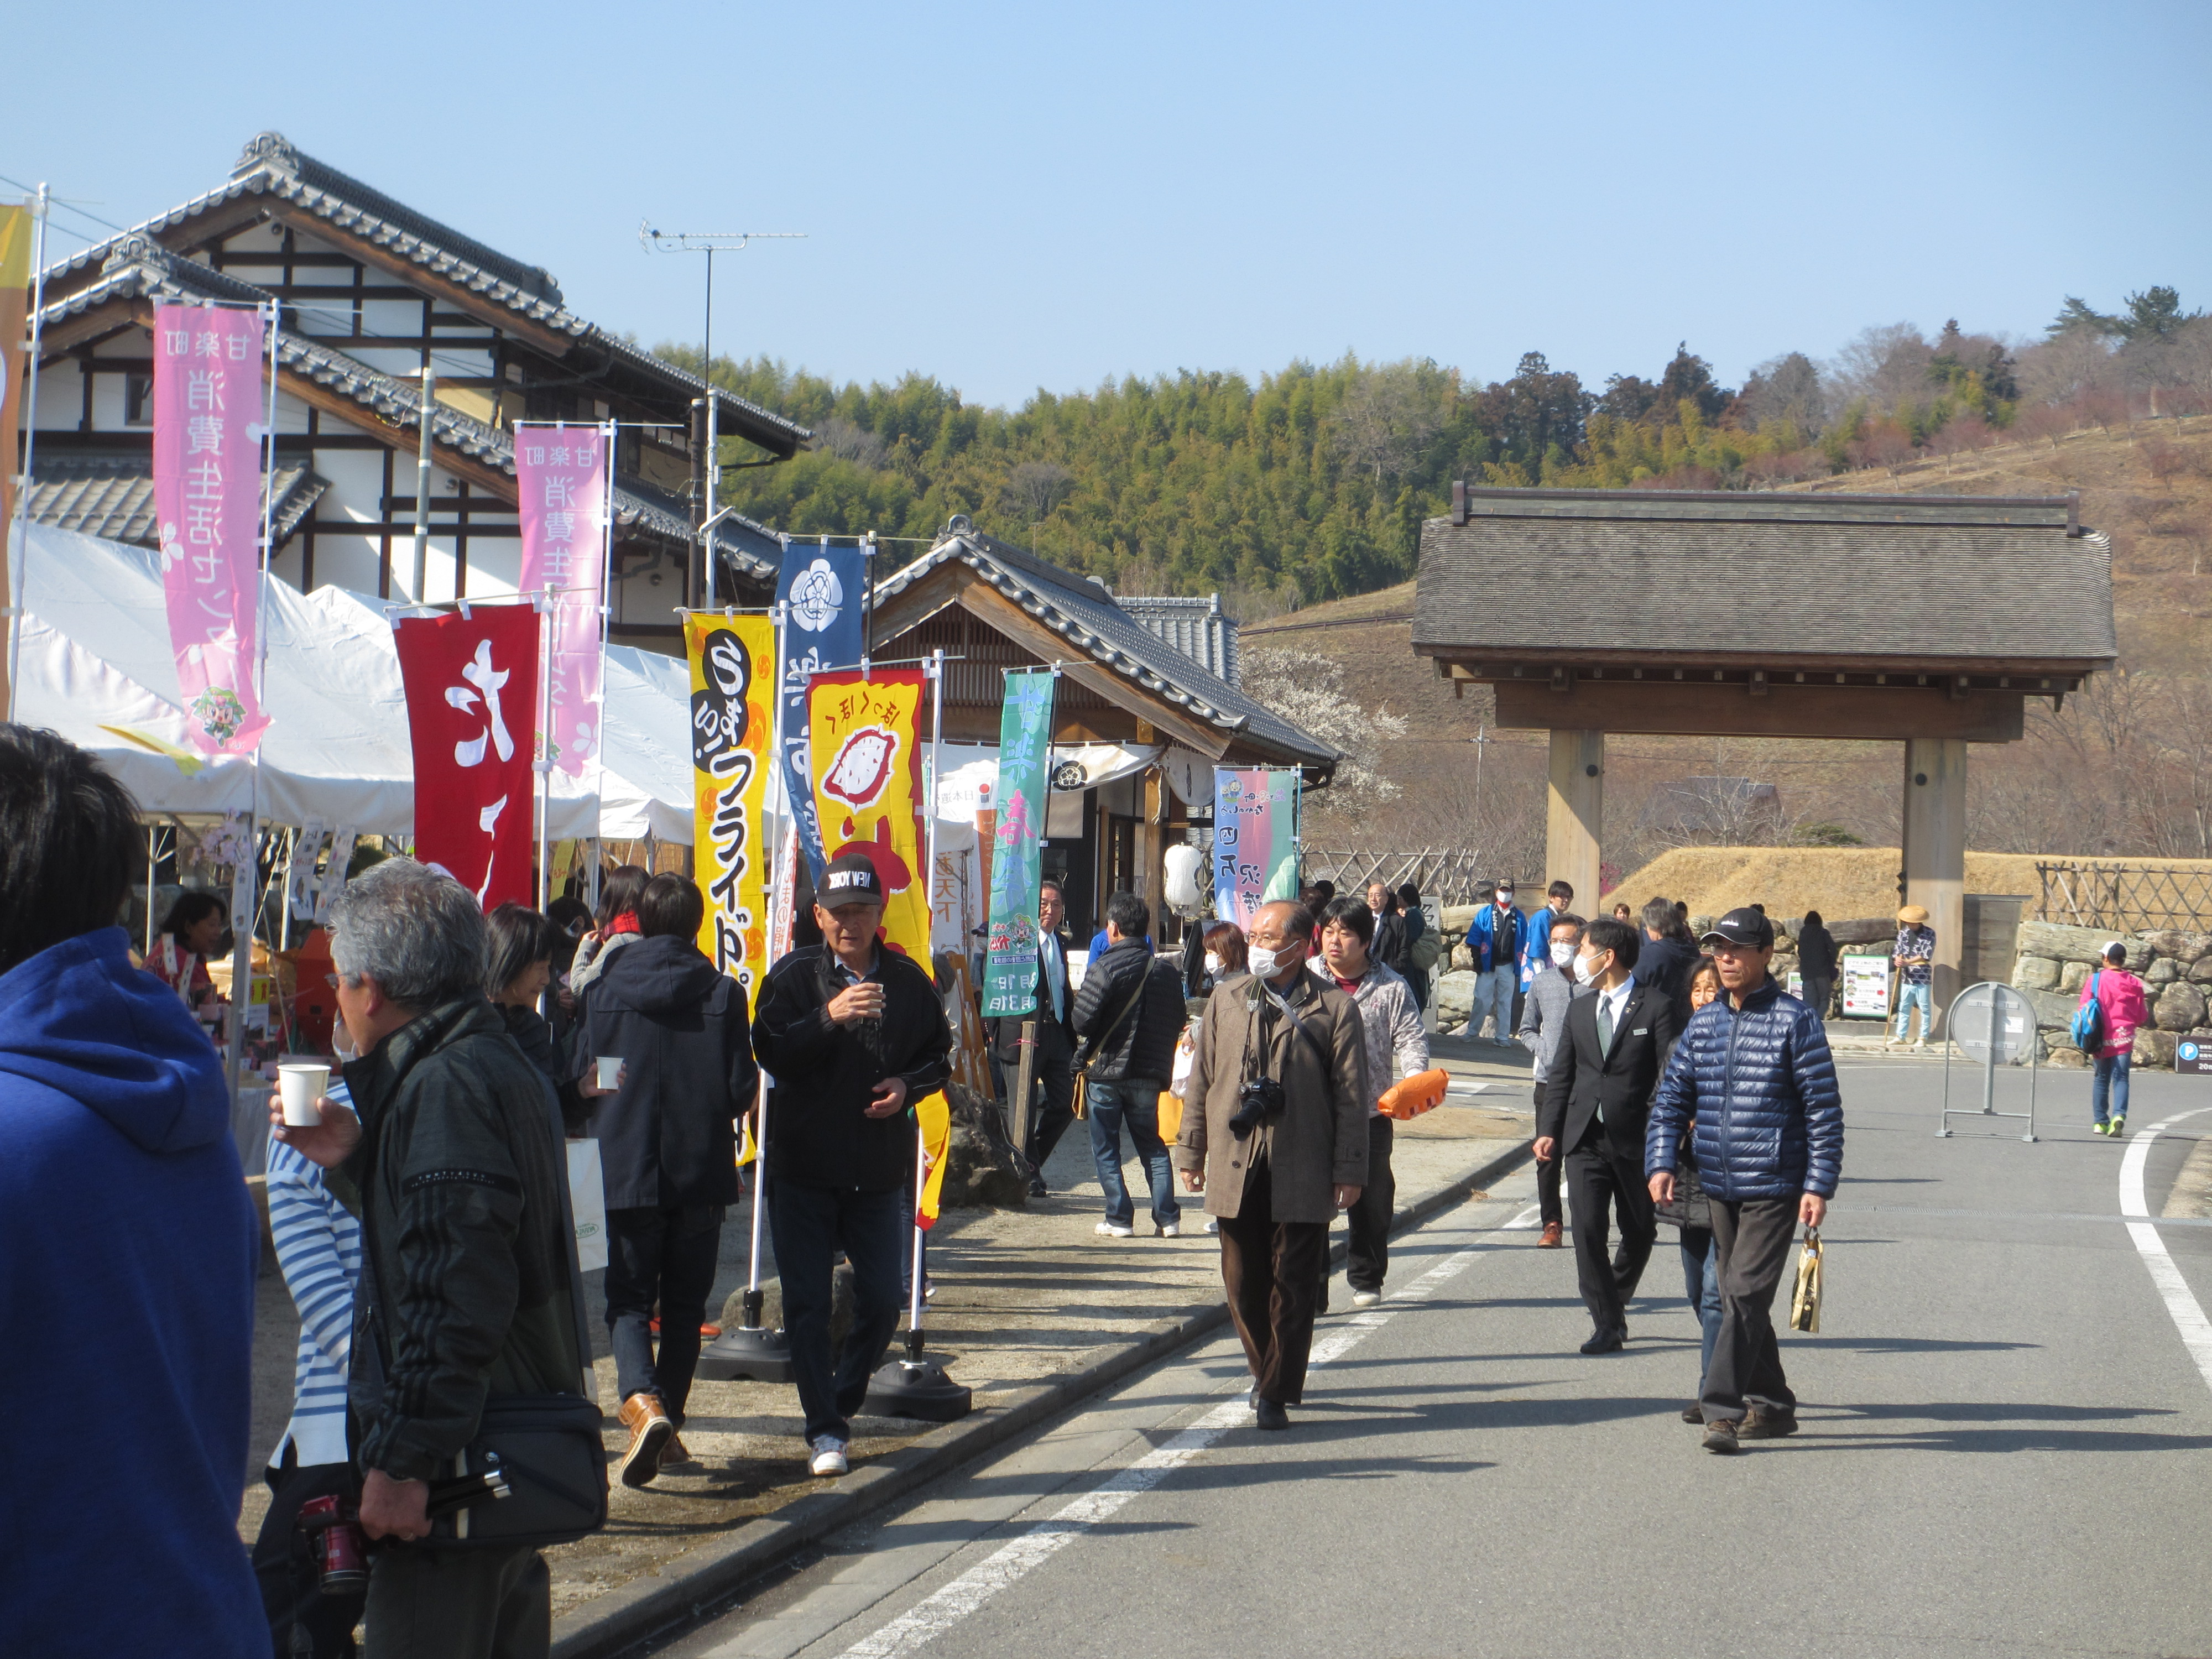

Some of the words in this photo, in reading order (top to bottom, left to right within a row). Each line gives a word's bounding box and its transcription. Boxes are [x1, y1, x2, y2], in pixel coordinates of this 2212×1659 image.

[708, 749, 756, 985] フライド
[2185, 1045, 2194, 1057] P
